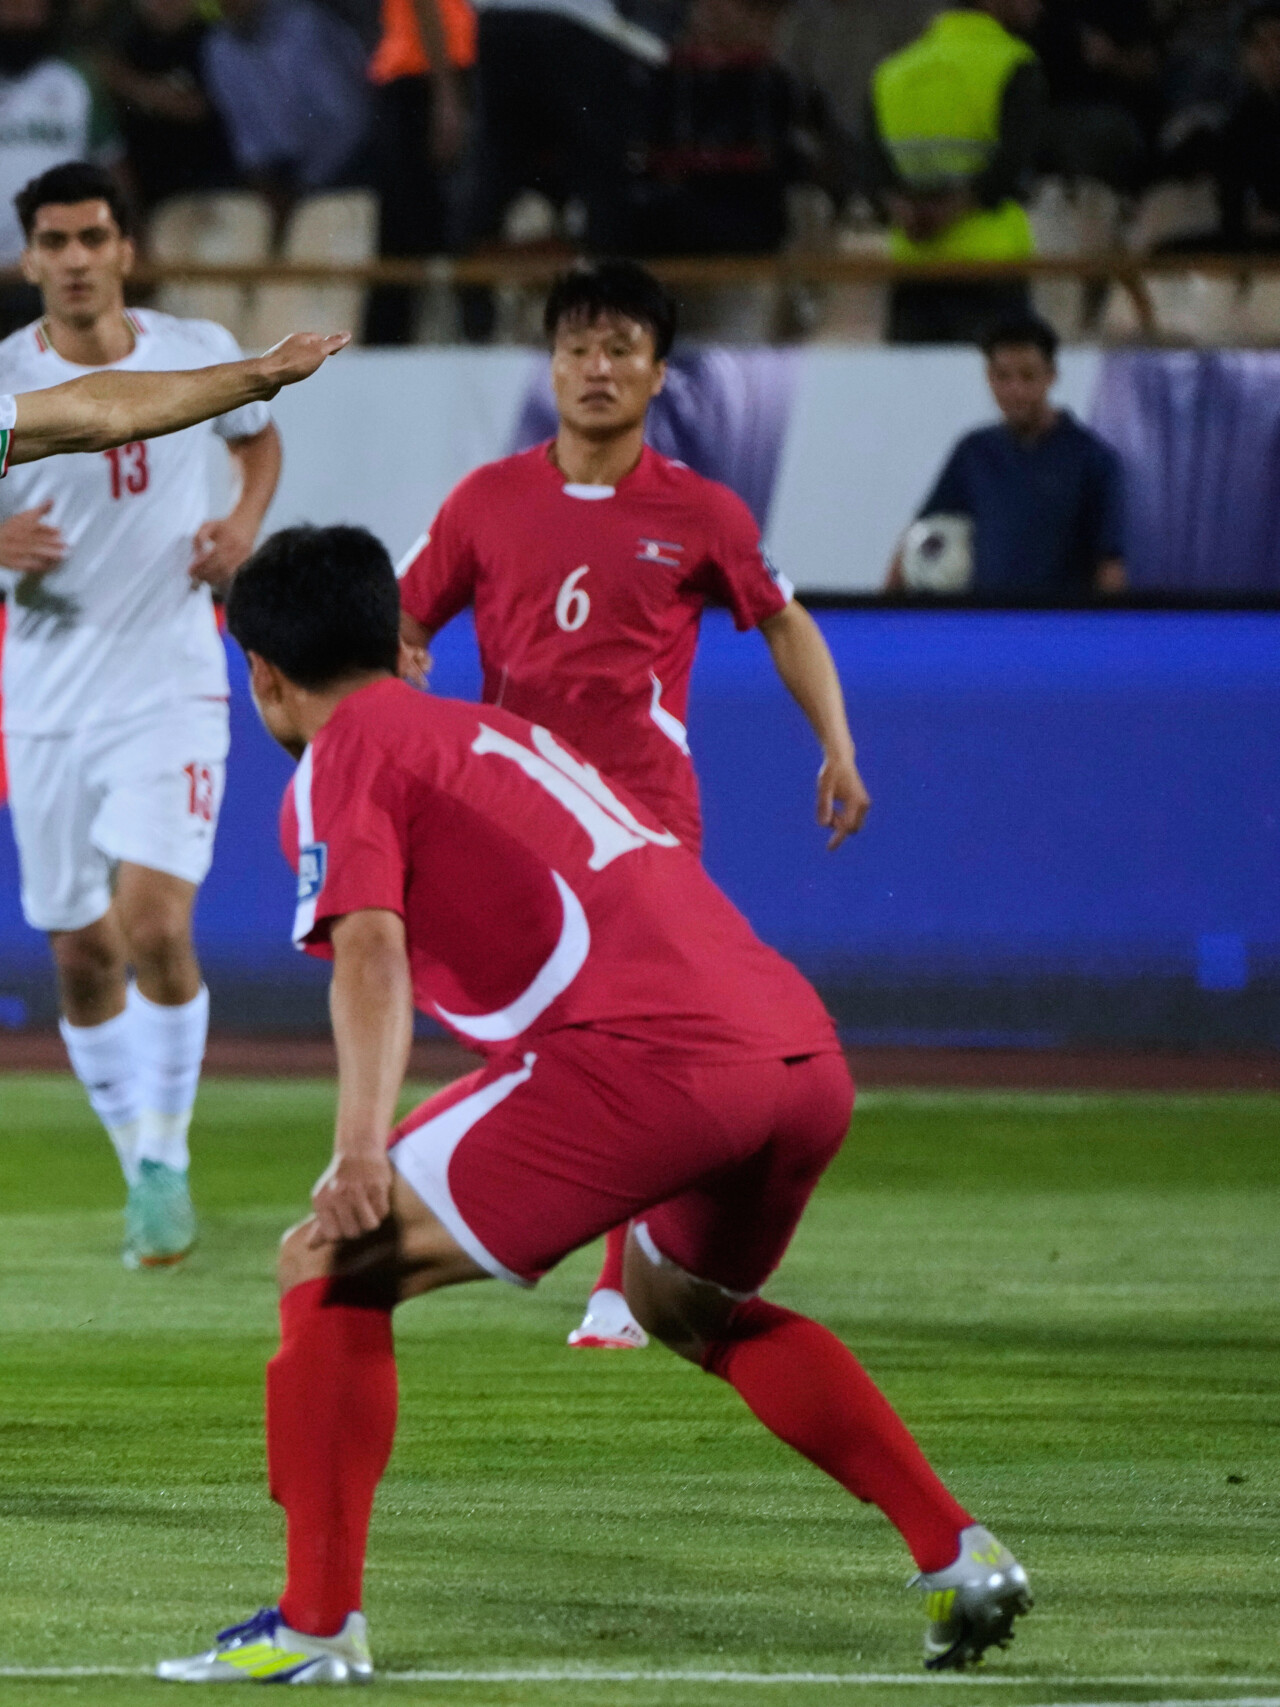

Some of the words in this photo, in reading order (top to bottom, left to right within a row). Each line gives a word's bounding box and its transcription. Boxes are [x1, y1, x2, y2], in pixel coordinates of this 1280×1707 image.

[103, 440, 149, 500] 13
[554, 564, 590, 632] 6
[183, 762, 212, 821] 13
